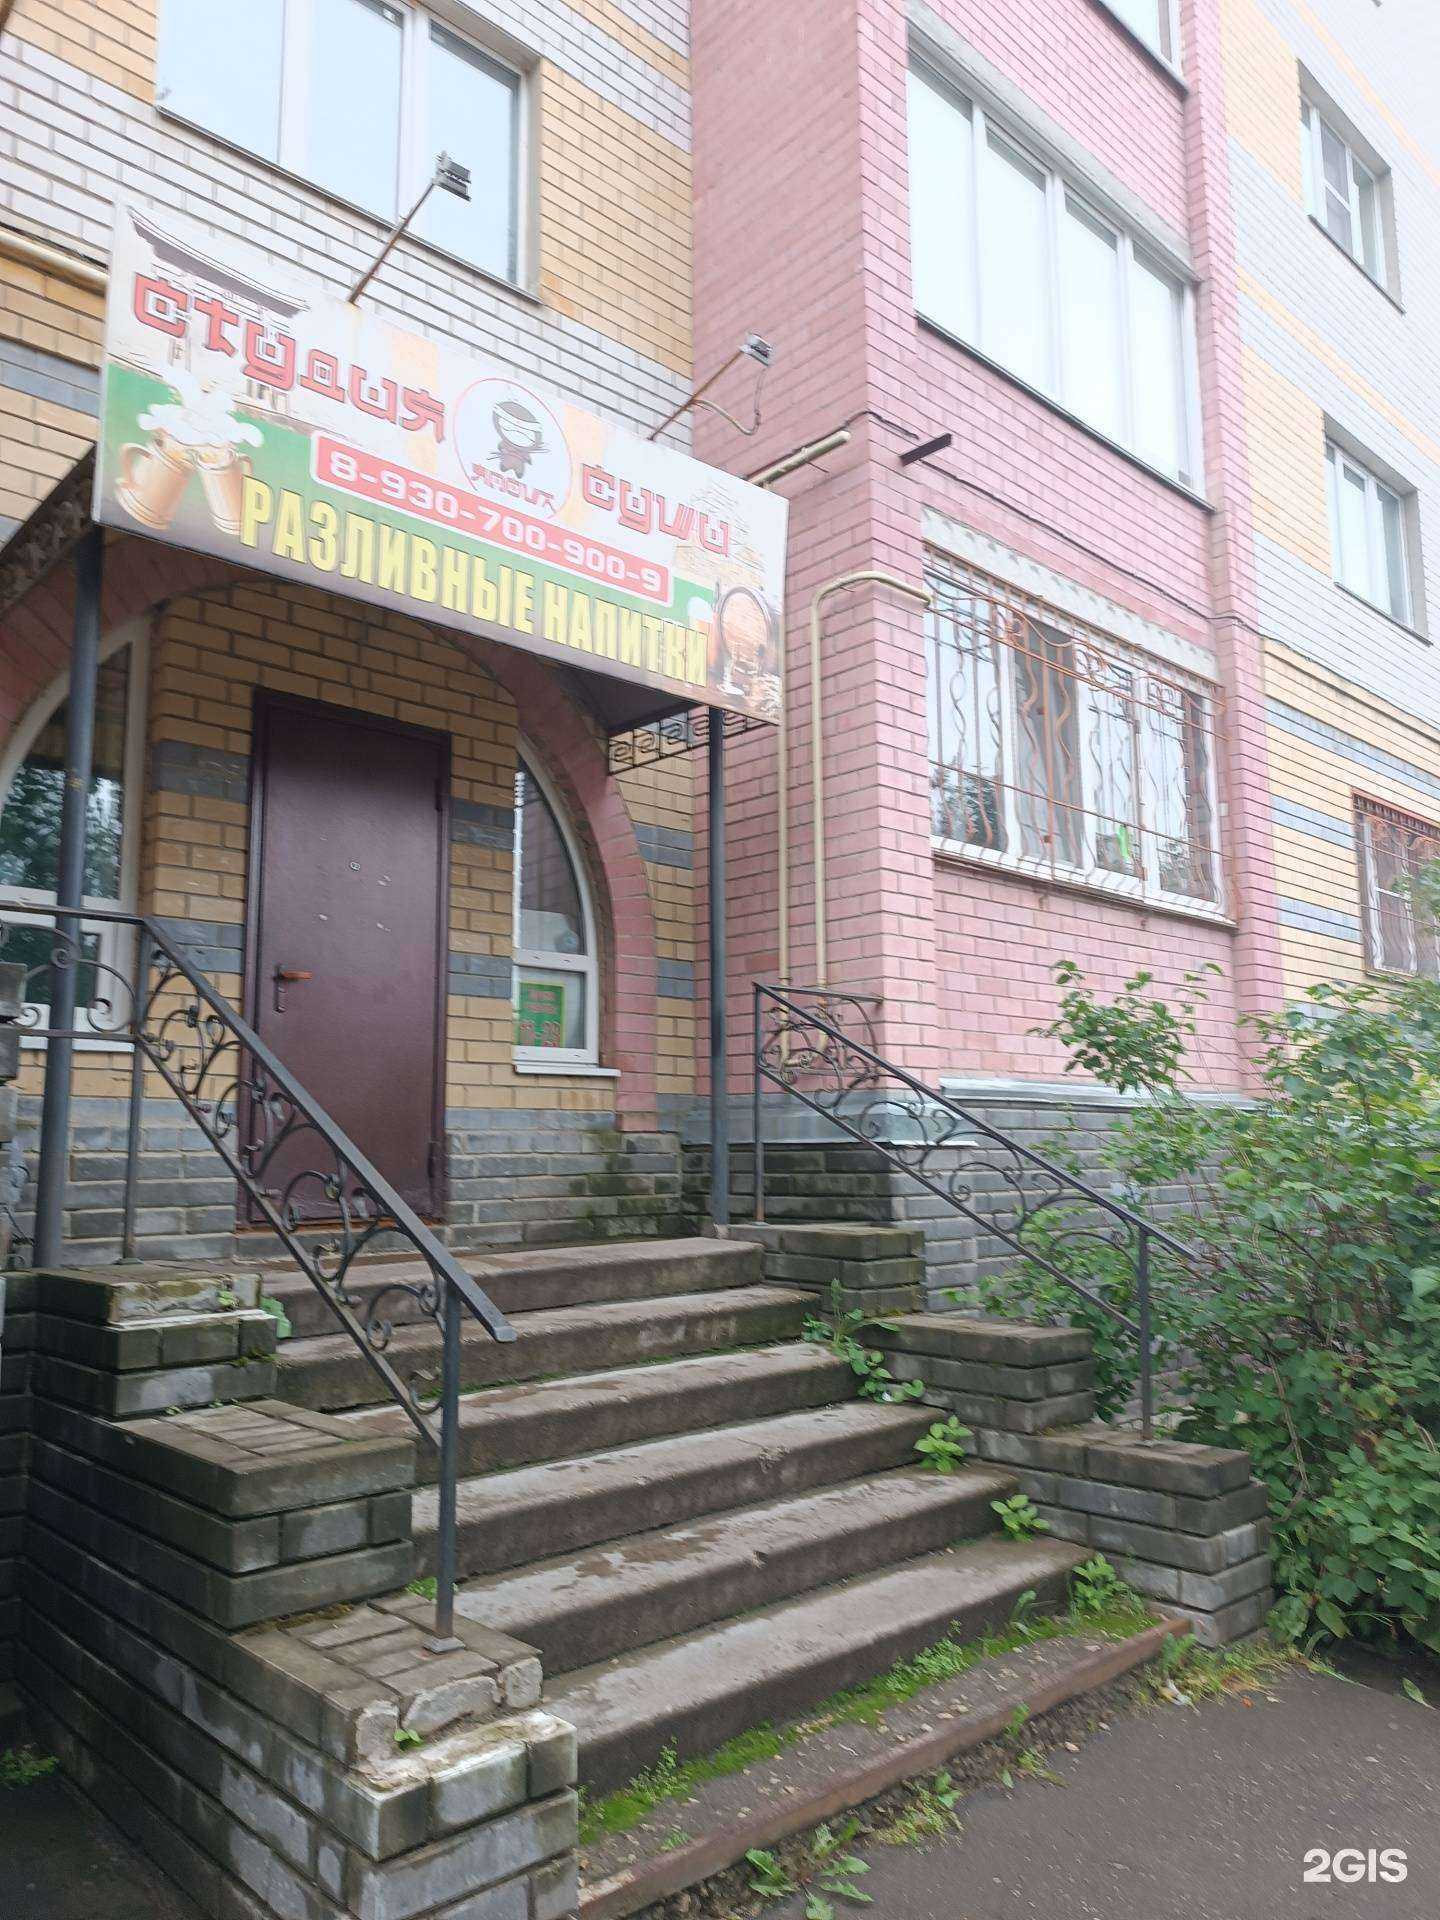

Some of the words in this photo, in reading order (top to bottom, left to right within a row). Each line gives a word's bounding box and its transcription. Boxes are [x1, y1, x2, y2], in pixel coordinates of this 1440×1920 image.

[239, 475, 535, 636] РАЗЛИВНЫЕ
[542, 579, 708, 688] НАПИТКИ
[329, 450, 662, 593] 8-930-700-900-9
